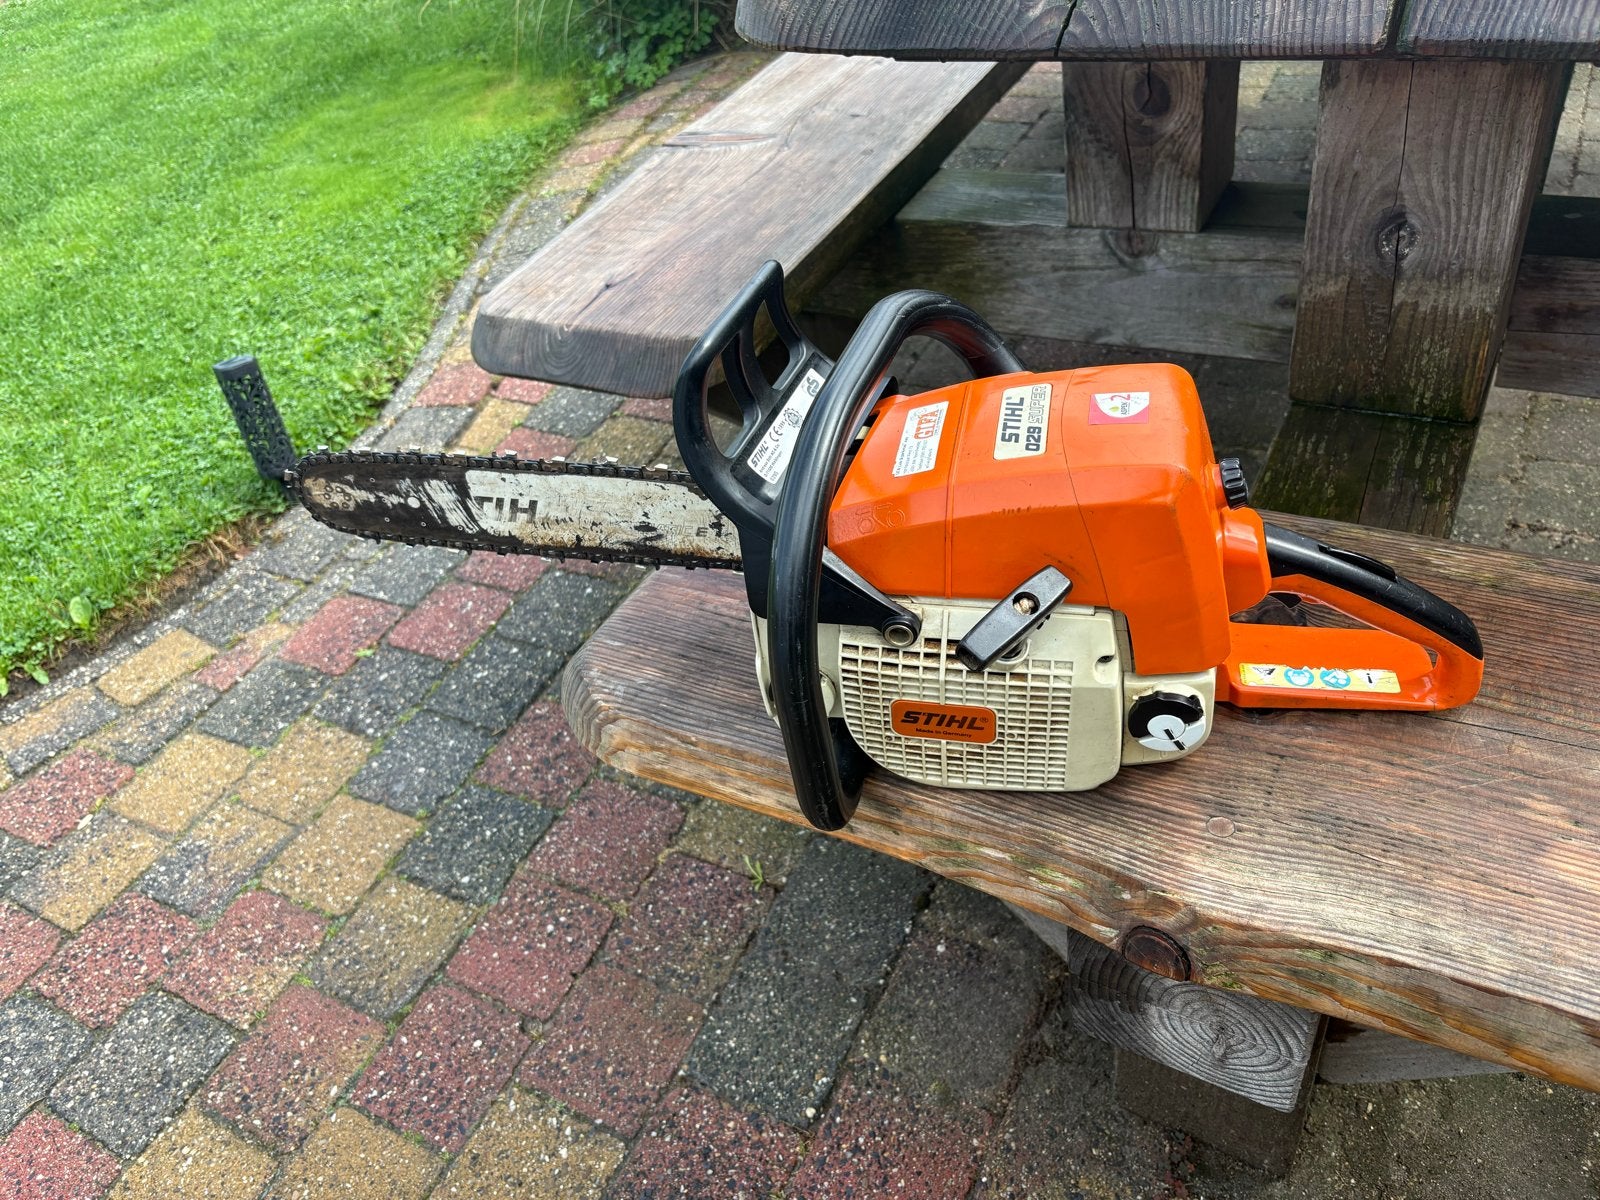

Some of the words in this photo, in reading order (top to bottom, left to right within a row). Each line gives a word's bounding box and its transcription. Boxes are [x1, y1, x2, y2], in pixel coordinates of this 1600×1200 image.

[1028, 386, 1047, 424] SUPER
[1000, 396, 1025, 444] STIHL
[1025, 426, 1042, 452] 029
[751, 443, 769, 467] STIHL
[900, 710, 985, 731] STIHL
[915, 727, 934, 735] Made
[942, 730, 972, 738] Germany
